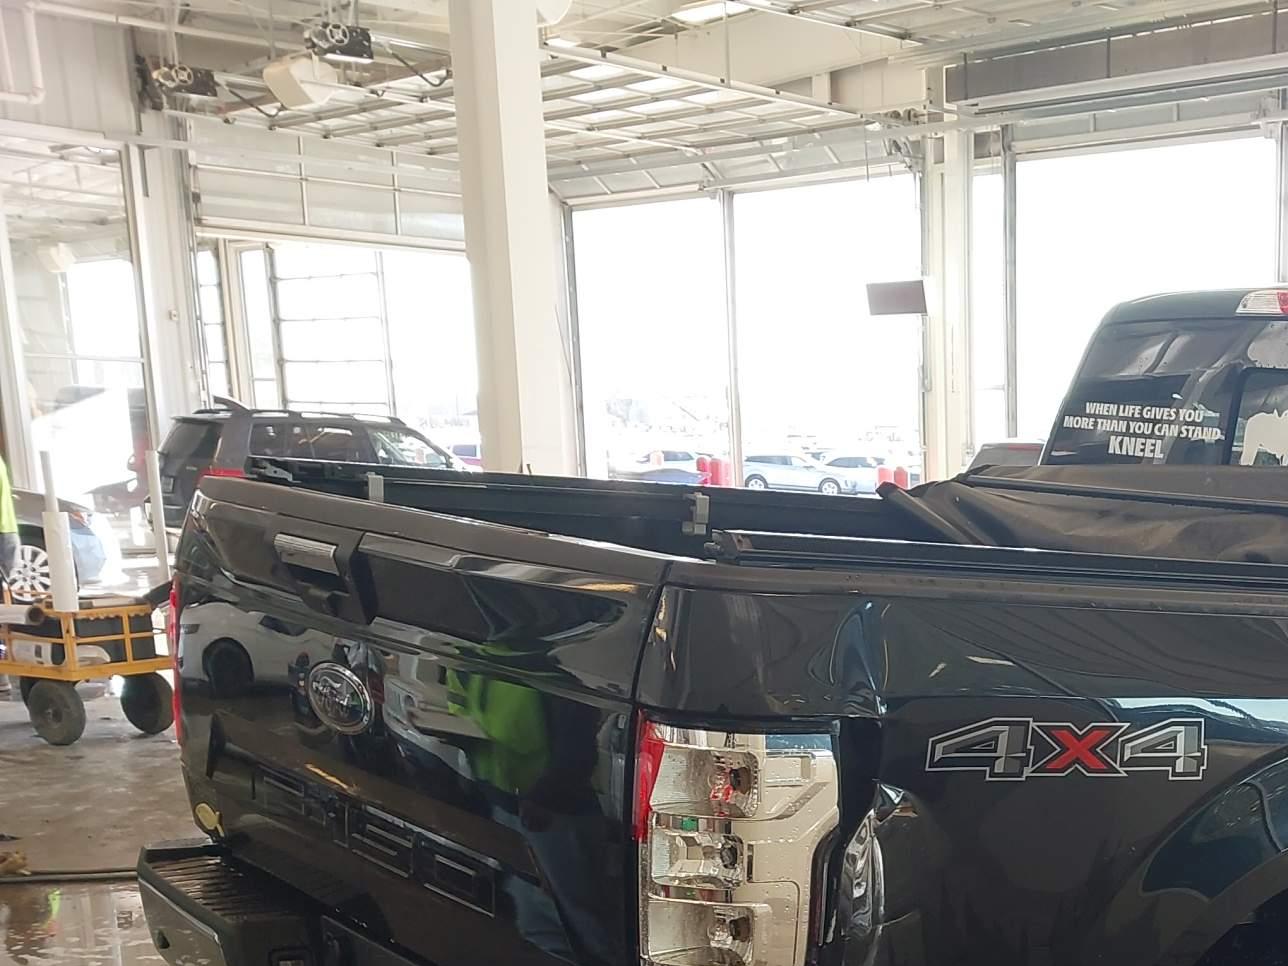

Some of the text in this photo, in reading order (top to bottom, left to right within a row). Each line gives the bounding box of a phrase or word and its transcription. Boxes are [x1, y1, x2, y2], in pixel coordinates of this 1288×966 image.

[1085, 402, 1204, 423] WHEN LIFE GIVES YOU
[1063, 415, 1094, 430] MORE
[1096, 418, 1128, 433] THAN
[1129, 421, 1153, 435] YOU
[1154, 423, 1179, 437] CAN
[1108, 435, 1164, 459] KNEEL
